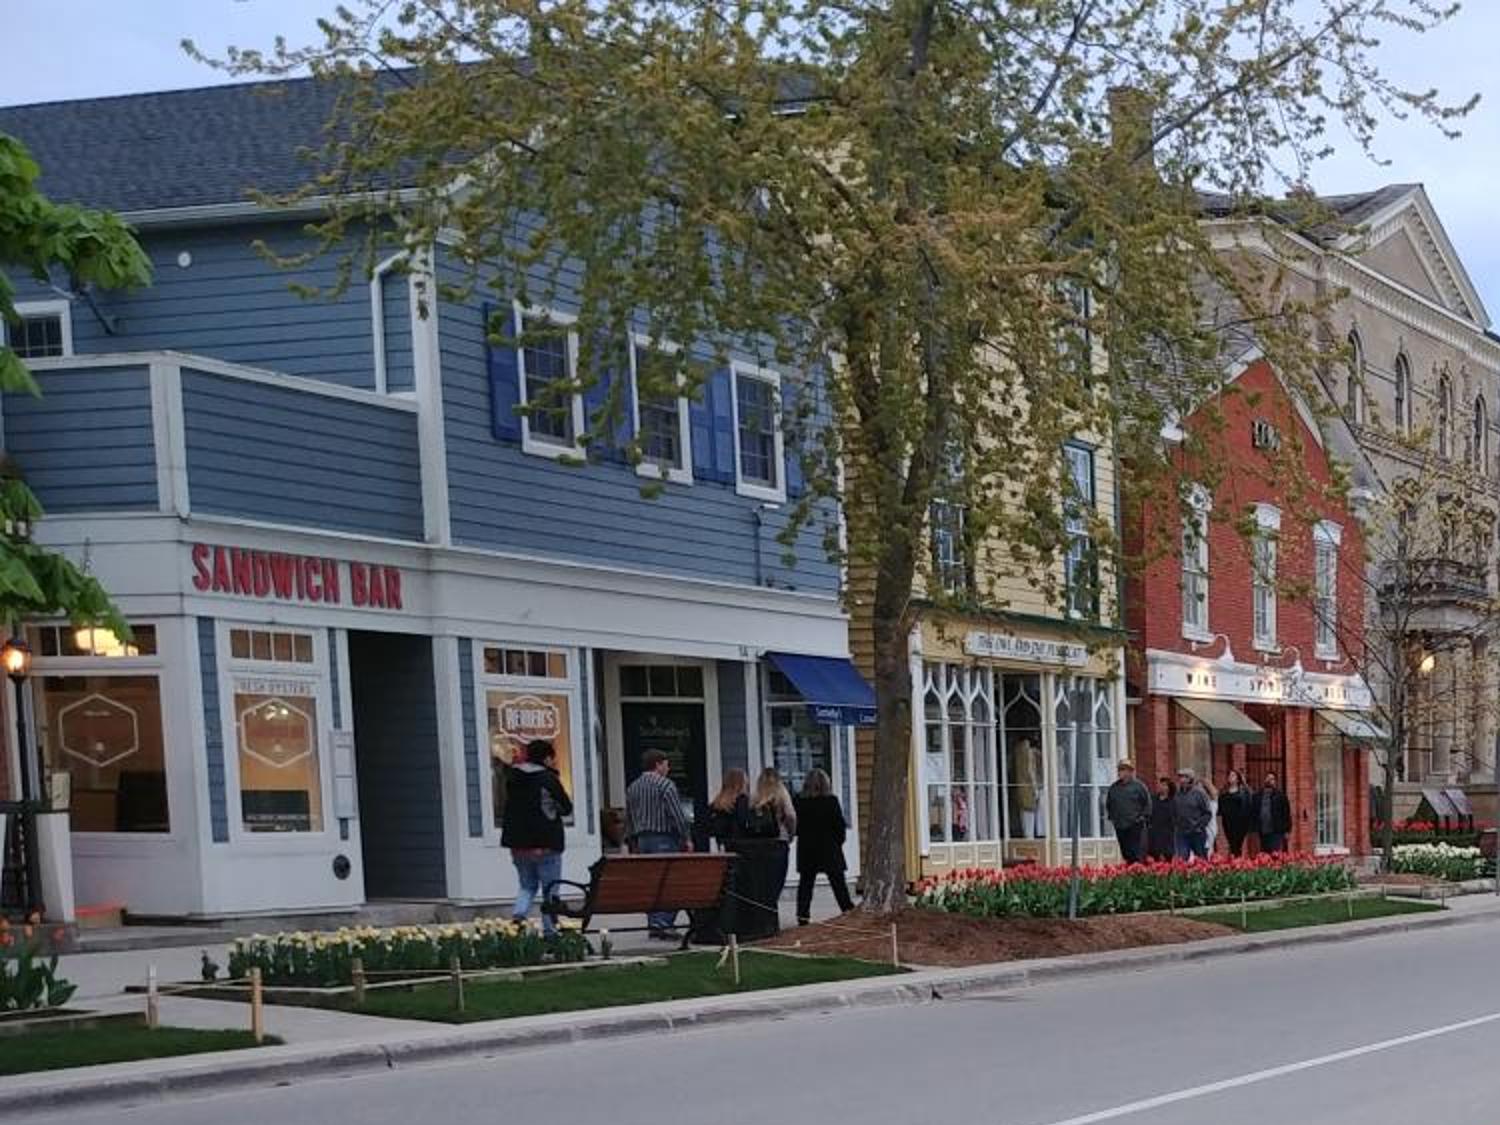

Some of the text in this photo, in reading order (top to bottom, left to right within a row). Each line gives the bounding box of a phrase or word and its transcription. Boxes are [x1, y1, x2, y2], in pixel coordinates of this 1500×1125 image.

[192, 542, 403, 610] SANDWICH BAR
[1186, 671, 1217, 689] WINE
